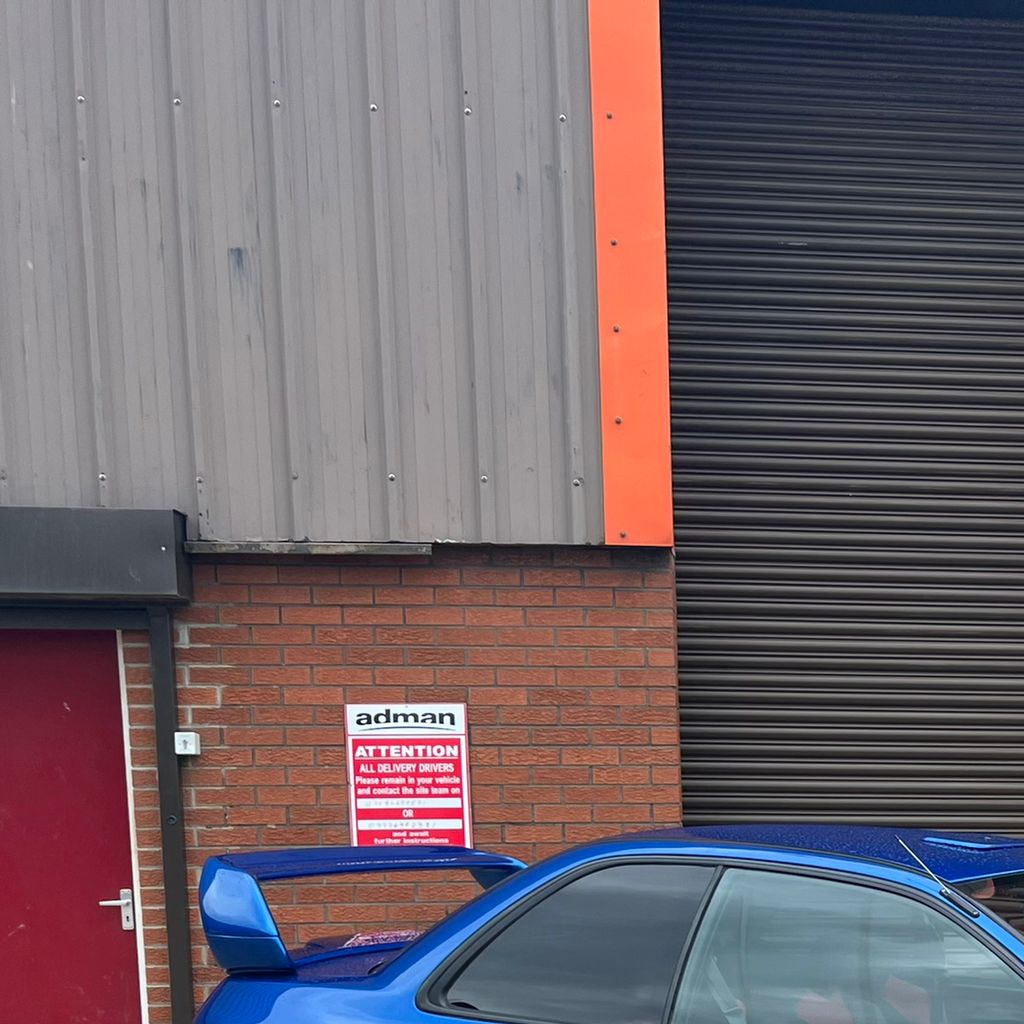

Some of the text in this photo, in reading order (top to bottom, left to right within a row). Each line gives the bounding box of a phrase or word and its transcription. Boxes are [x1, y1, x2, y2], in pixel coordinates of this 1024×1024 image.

[356, 708, 456, 726] adman
[355, 744, 459, 757] ATTENTION
[359, 763, 455, 773] ALL DELIVERY DRIVERS
[355, 775, 460, 786] Please remain in your vehicle
[357, 787, 371, 795] and
[372, 787, 400, 795] contact
[402, 787, 414, 795] the
[416, 786, 429, 795] site
[431, 787, 449, 795] team
[402, 809, 414, 818] OR
